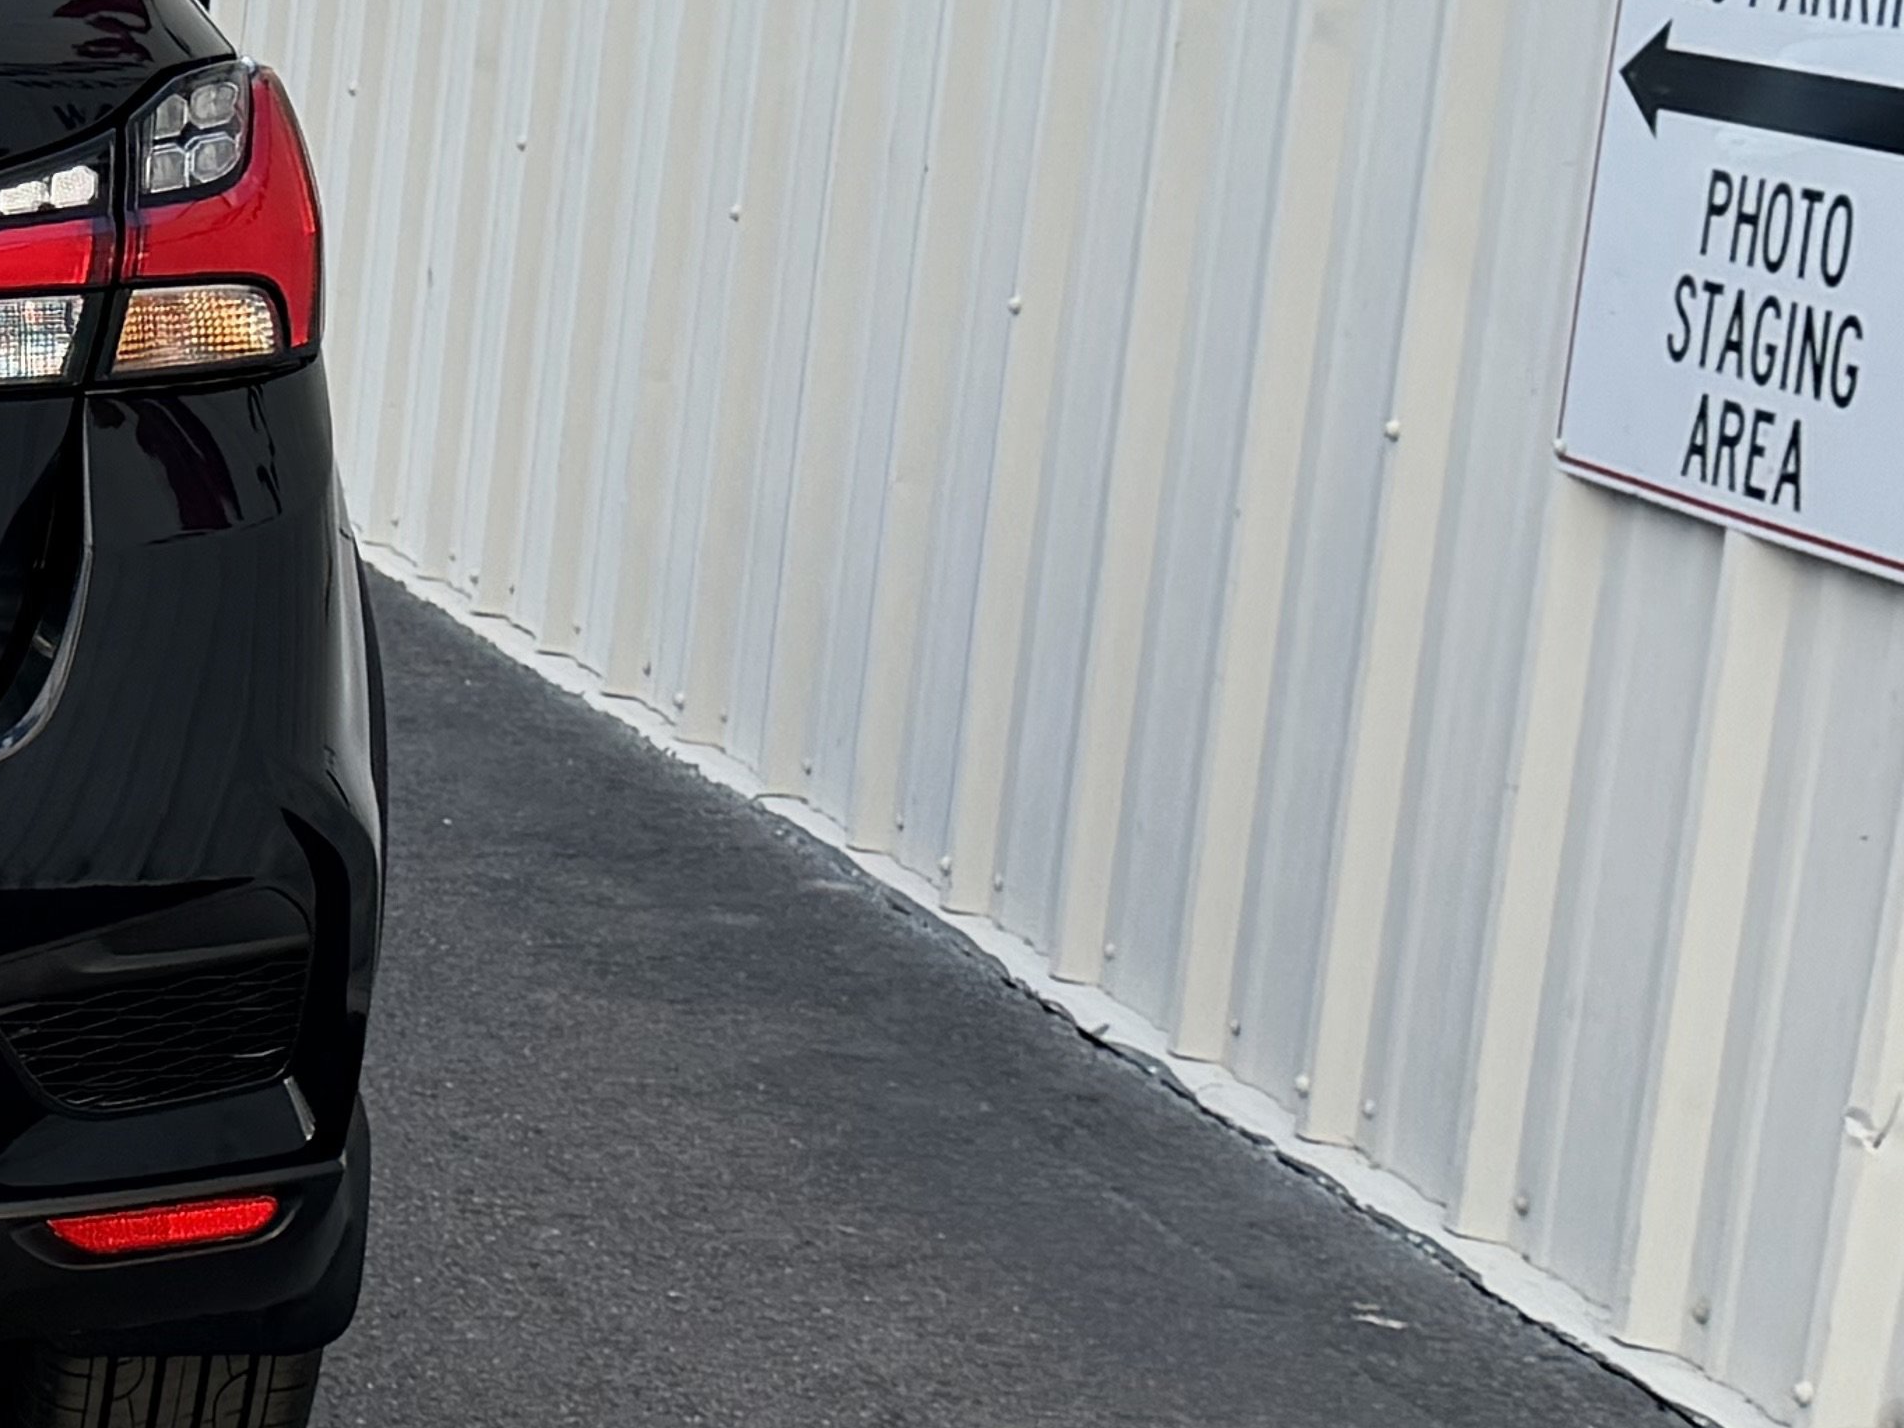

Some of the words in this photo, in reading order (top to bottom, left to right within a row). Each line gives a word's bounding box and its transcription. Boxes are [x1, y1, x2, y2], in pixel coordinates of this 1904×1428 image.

[1700, 169, 1854, 288] PHOTO
[1667, 274, 1863, 409] STAGING
[1681, 393, 1801, 512] AREA
